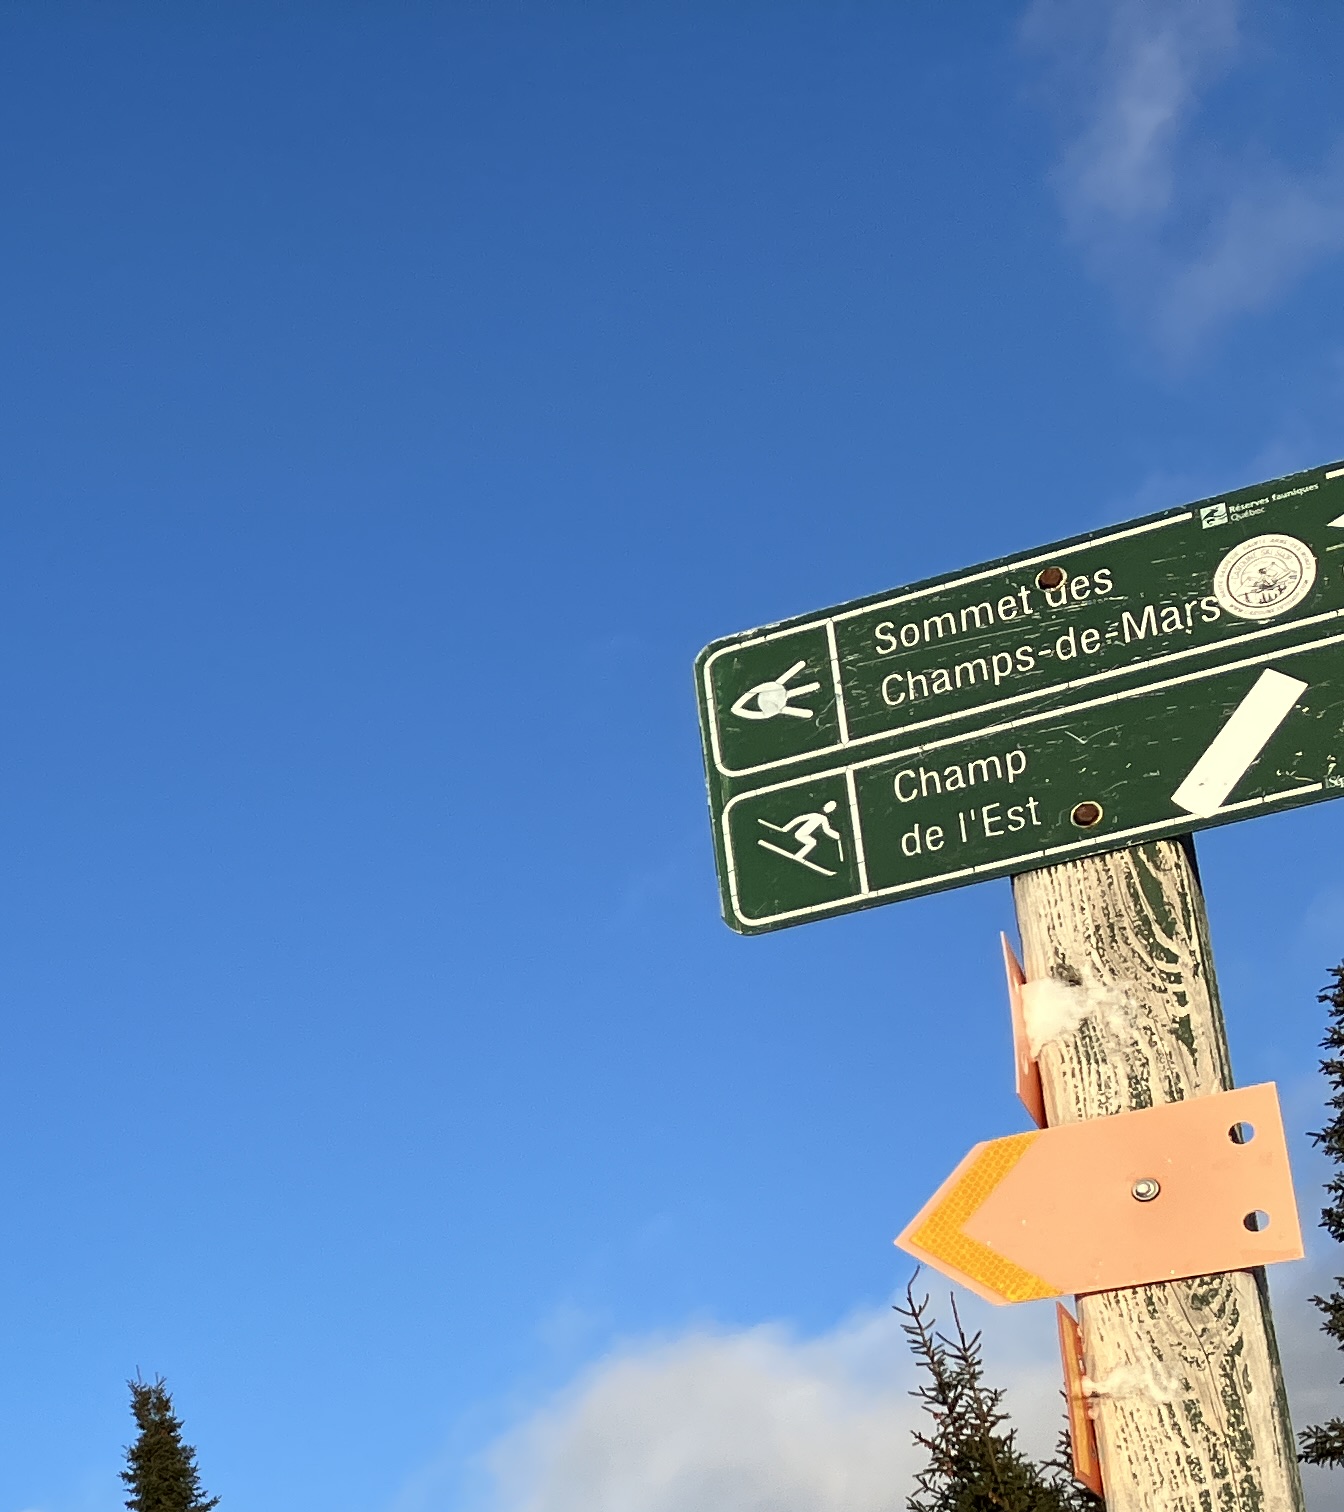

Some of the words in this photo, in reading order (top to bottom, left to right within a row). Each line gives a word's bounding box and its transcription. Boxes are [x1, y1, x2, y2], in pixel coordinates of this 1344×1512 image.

[1229, 496, 1270, 514] Réserves
[1272, 483, 1319, 501] fauniques
[1231, 507, 1265, 521] Québec
[874, 584, 1034, 656] Sommet
[881, 595, 1221, 706] Champs-de-Mars
[894, 749, 1027, 803] Champ
[900, 823, 945, 857] de
[958, 796, 1042, 843] l'Est
